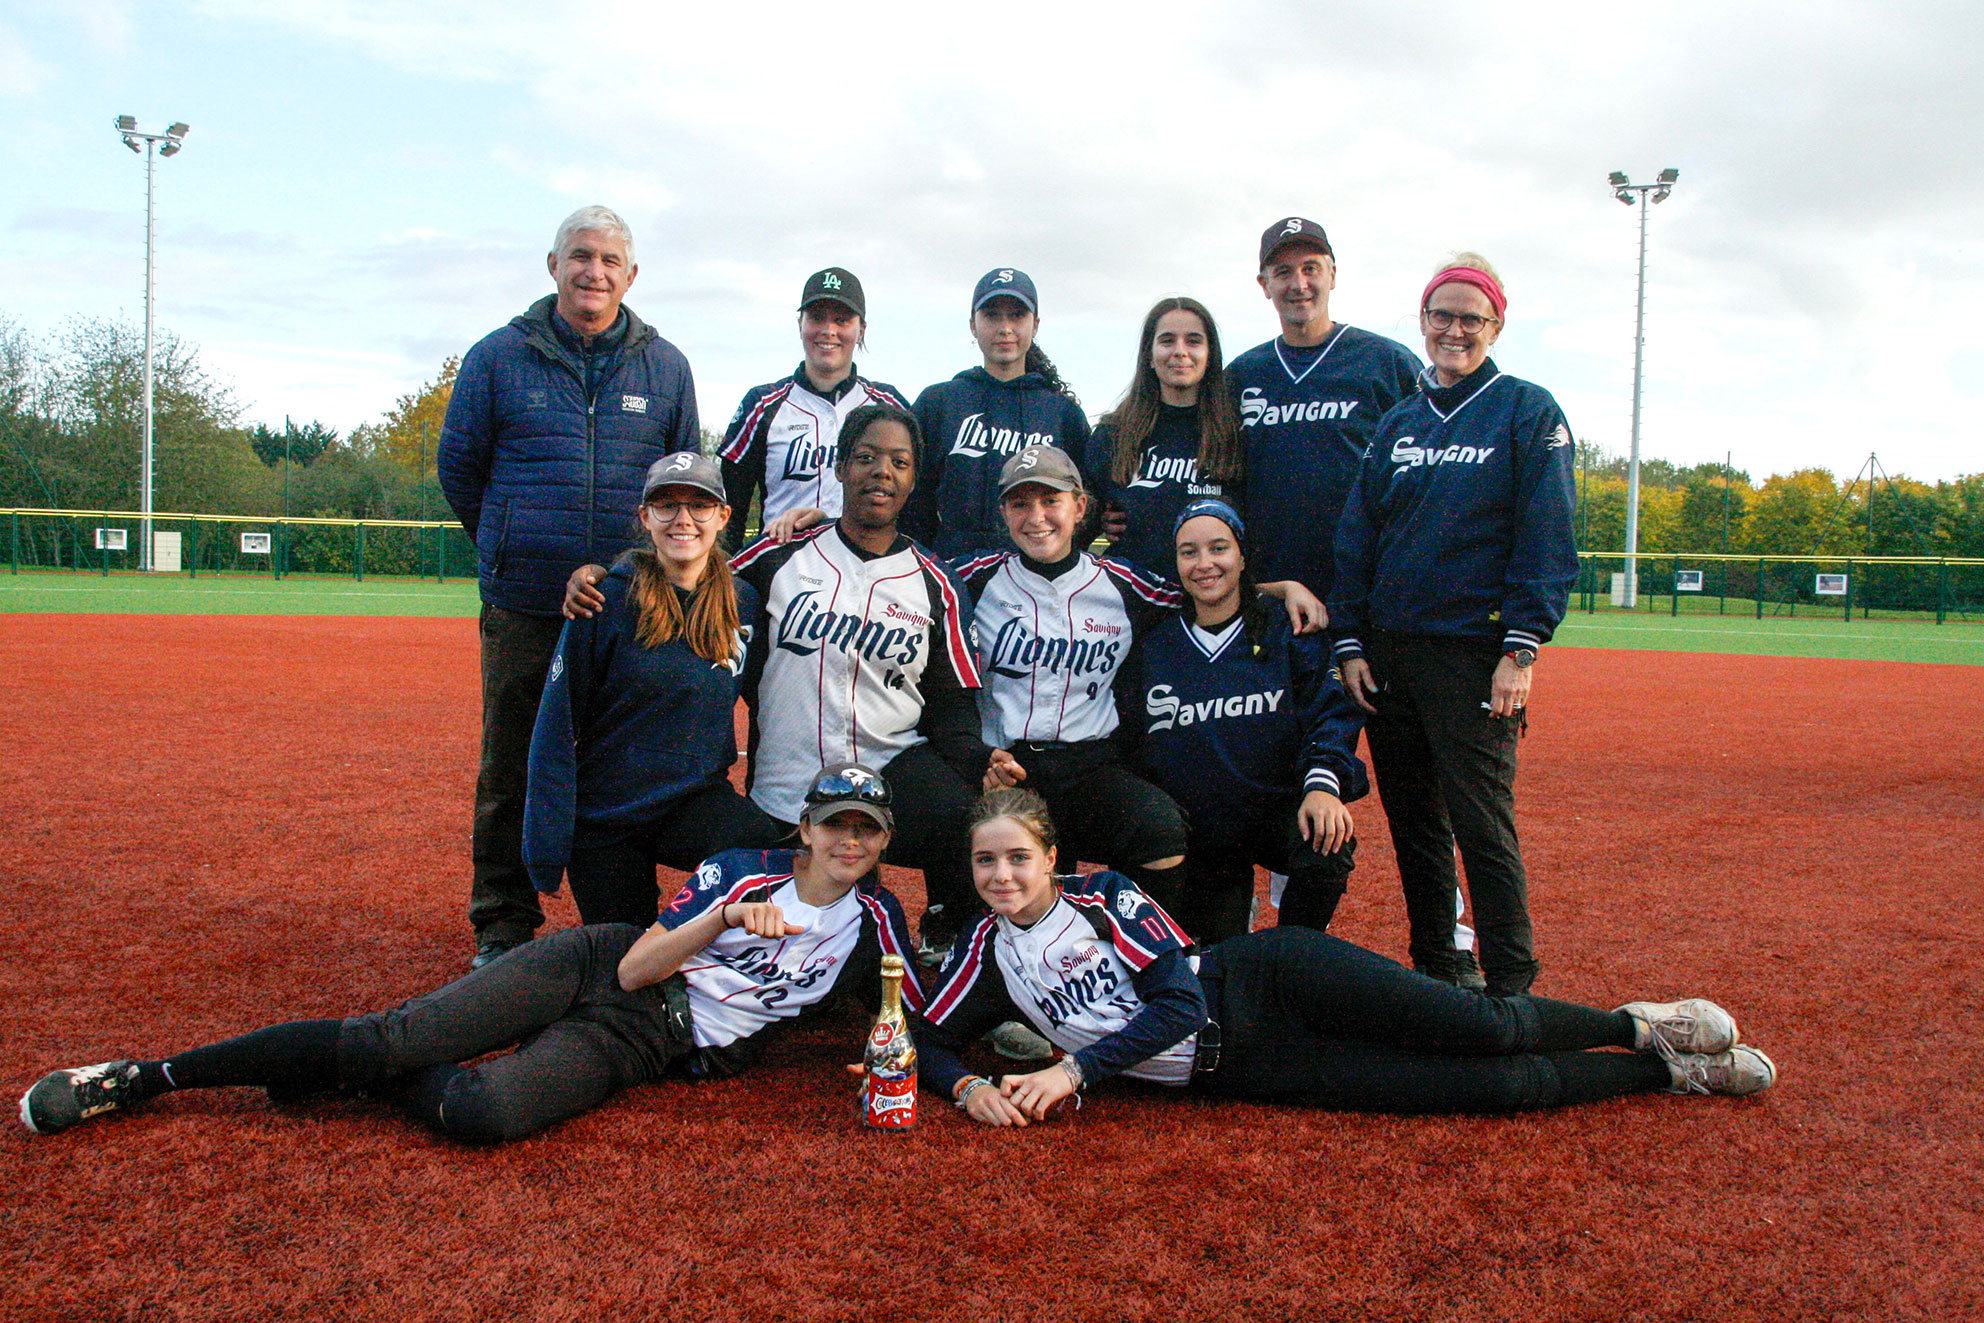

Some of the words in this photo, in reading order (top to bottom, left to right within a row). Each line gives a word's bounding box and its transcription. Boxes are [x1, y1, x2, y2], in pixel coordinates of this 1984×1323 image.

[1280, 218, 1302, 237] S
[822, 271, 842, 290] LA
[992, 269, 1014, 284] S
[664, 453, 694, 472] S
[1015, 449, 1040, 472] S
[776, 590, 923, 666] Lionnes
[1080, 617, 1122, 637] Savigny
[986, 615, 1120, 679] Lionnes
[1140, 916, 1169, 941] 11
[1060, 944, 1100, 974] Savigny
[753, 985, 789, 1010] 12
